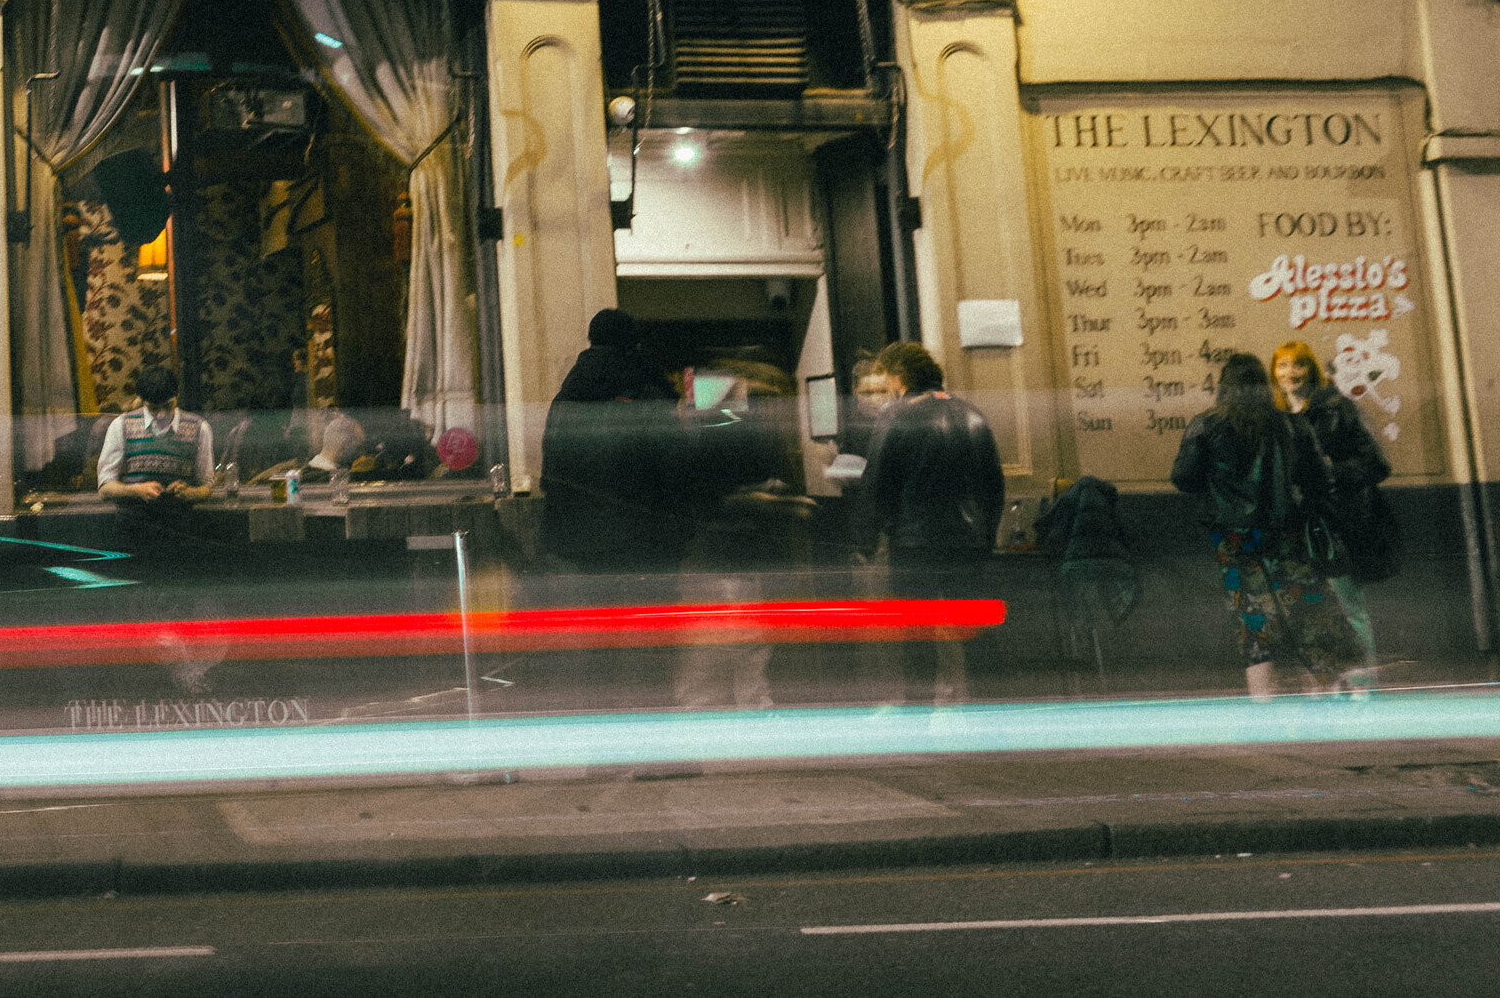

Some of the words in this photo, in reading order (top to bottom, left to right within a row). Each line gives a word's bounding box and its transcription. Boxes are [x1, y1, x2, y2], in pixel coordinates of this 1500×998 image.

[1046, 114, 1128, 148] THE
[1143, 113, 1382, 148] LEXINGTON
[1060, 213, 1102, 233] Mon
[1127, 213, 1167, 241] 3pm
[1186, 212, 1227, 233] 2am
[1258, 212, 1338, 238] FOOD
[1347, 211, 1391, 238] BY:
[1130, 246, 1172, 273] 3pm
[1188, 244, 1229, 264] 2am
[1065, 278, 1108, 298] Wed
[1133, 276, 1173, 305] 3pm
[1193, 275, 1232, 297] 2am
[1248, 254, 1409, 302] Alessio's
[1136, 306, 1179, 337] 3pm
[1199, 307, 1236, 330] 3am
[1071, 344, 1100, 367] Fri
[1139, 341, 1183, 371] 3pm
[1142, 375, 1186, 402] 3pm
[1076, 410, 1113, 431] Sun
[1146, 409, 1187, 436] 3pm
[65, 699, 123, 730] THE
[132, 697, 309, 730] LEXINGTON
